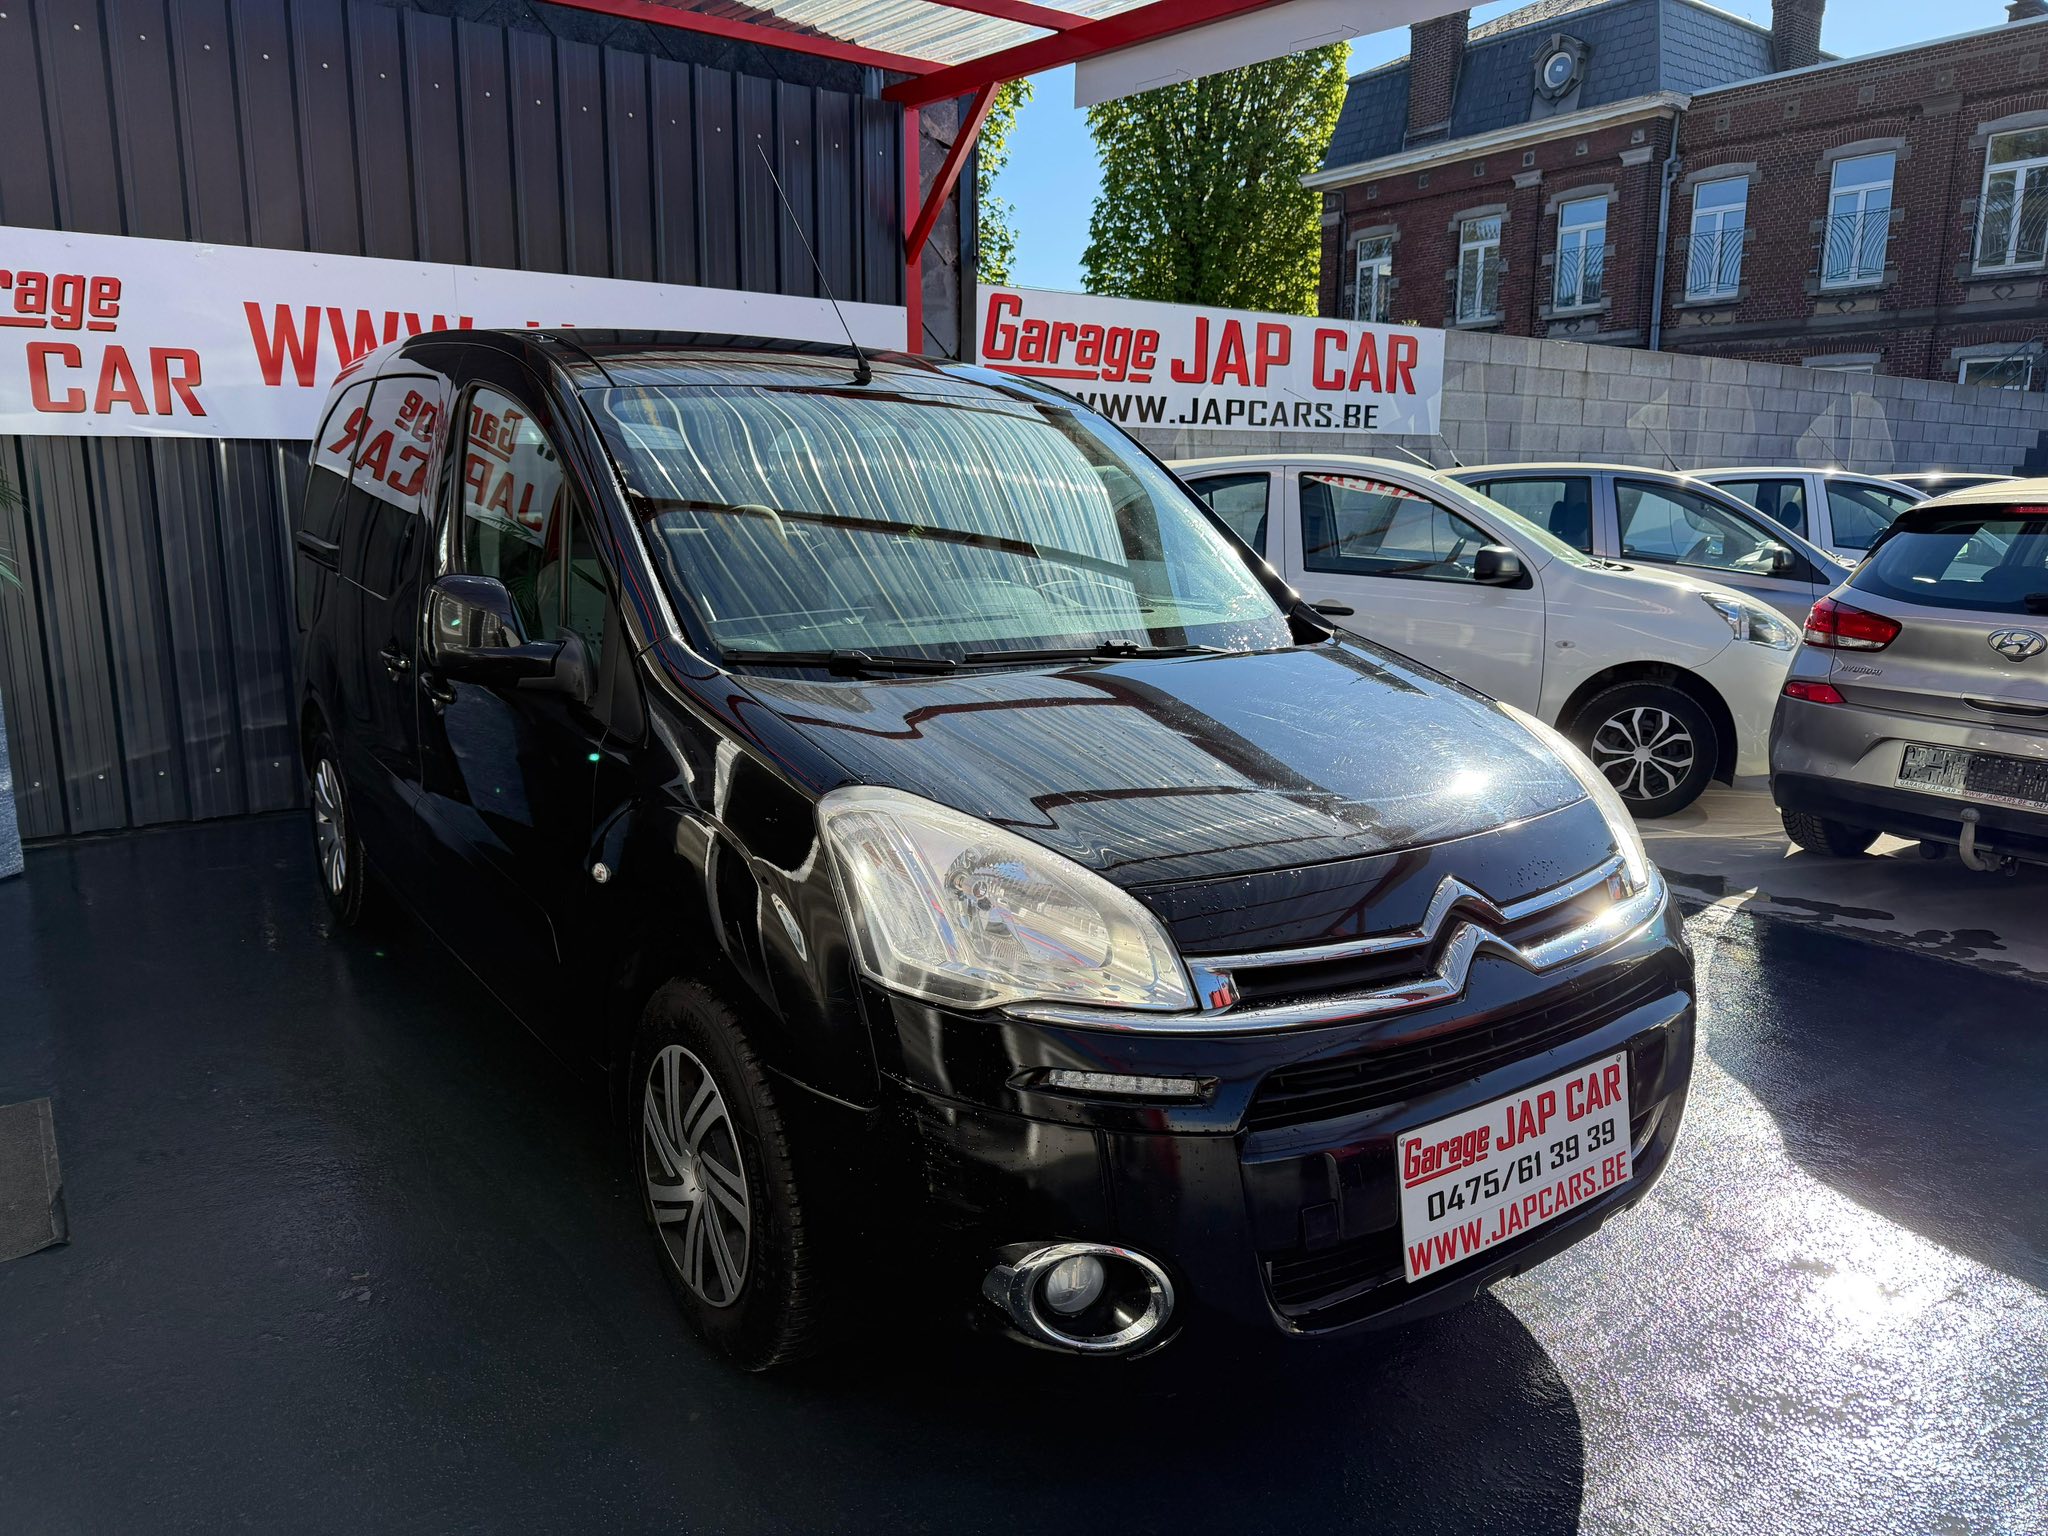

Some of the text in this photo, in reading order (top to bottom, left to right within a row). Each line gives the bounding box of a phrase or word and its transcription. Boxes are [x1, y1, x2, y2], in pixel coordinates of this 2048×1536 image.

[26, 341, 208, 417] CAR
[982, 292, 1419, 395] Garage JAP CAR
[1403, 1063, 1622, 1189] Garage JAP CAR
[1427, 1118, 1616, 1222] 0475/61 39 39
[1407, 1151, 1628, 1277] WWW.JAPCARS.BE
